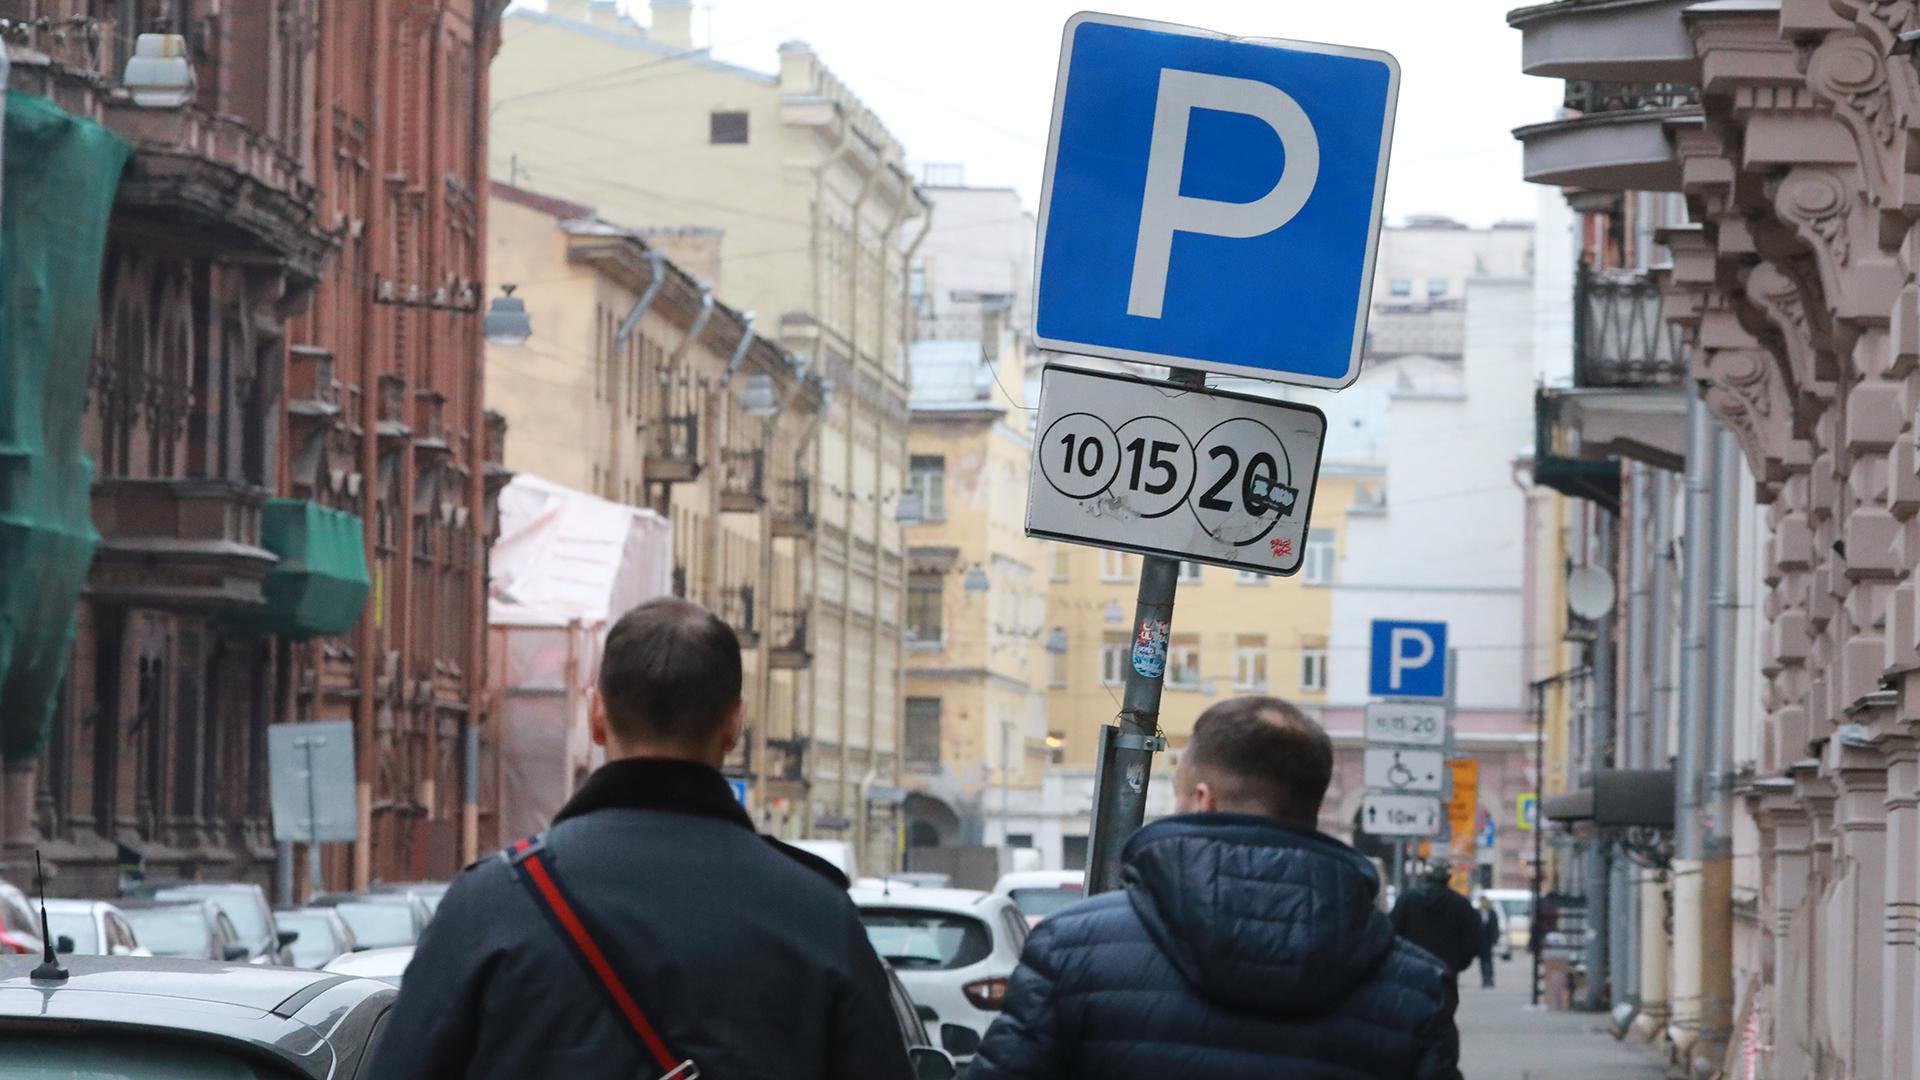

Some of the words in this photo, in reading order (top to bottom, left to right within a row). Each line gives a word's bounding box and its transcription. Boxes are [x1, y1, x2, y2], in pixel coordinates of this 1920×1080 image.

[1126, 67, 1320, 320] P
[1060, 433, 1104, 477] 10
[1126, 437, 1180, 495] 15
[1199, 445, 1278, 517] 20
[1390, 628, 1435, 690] P
[1411, 715, 1436, 733] 20
